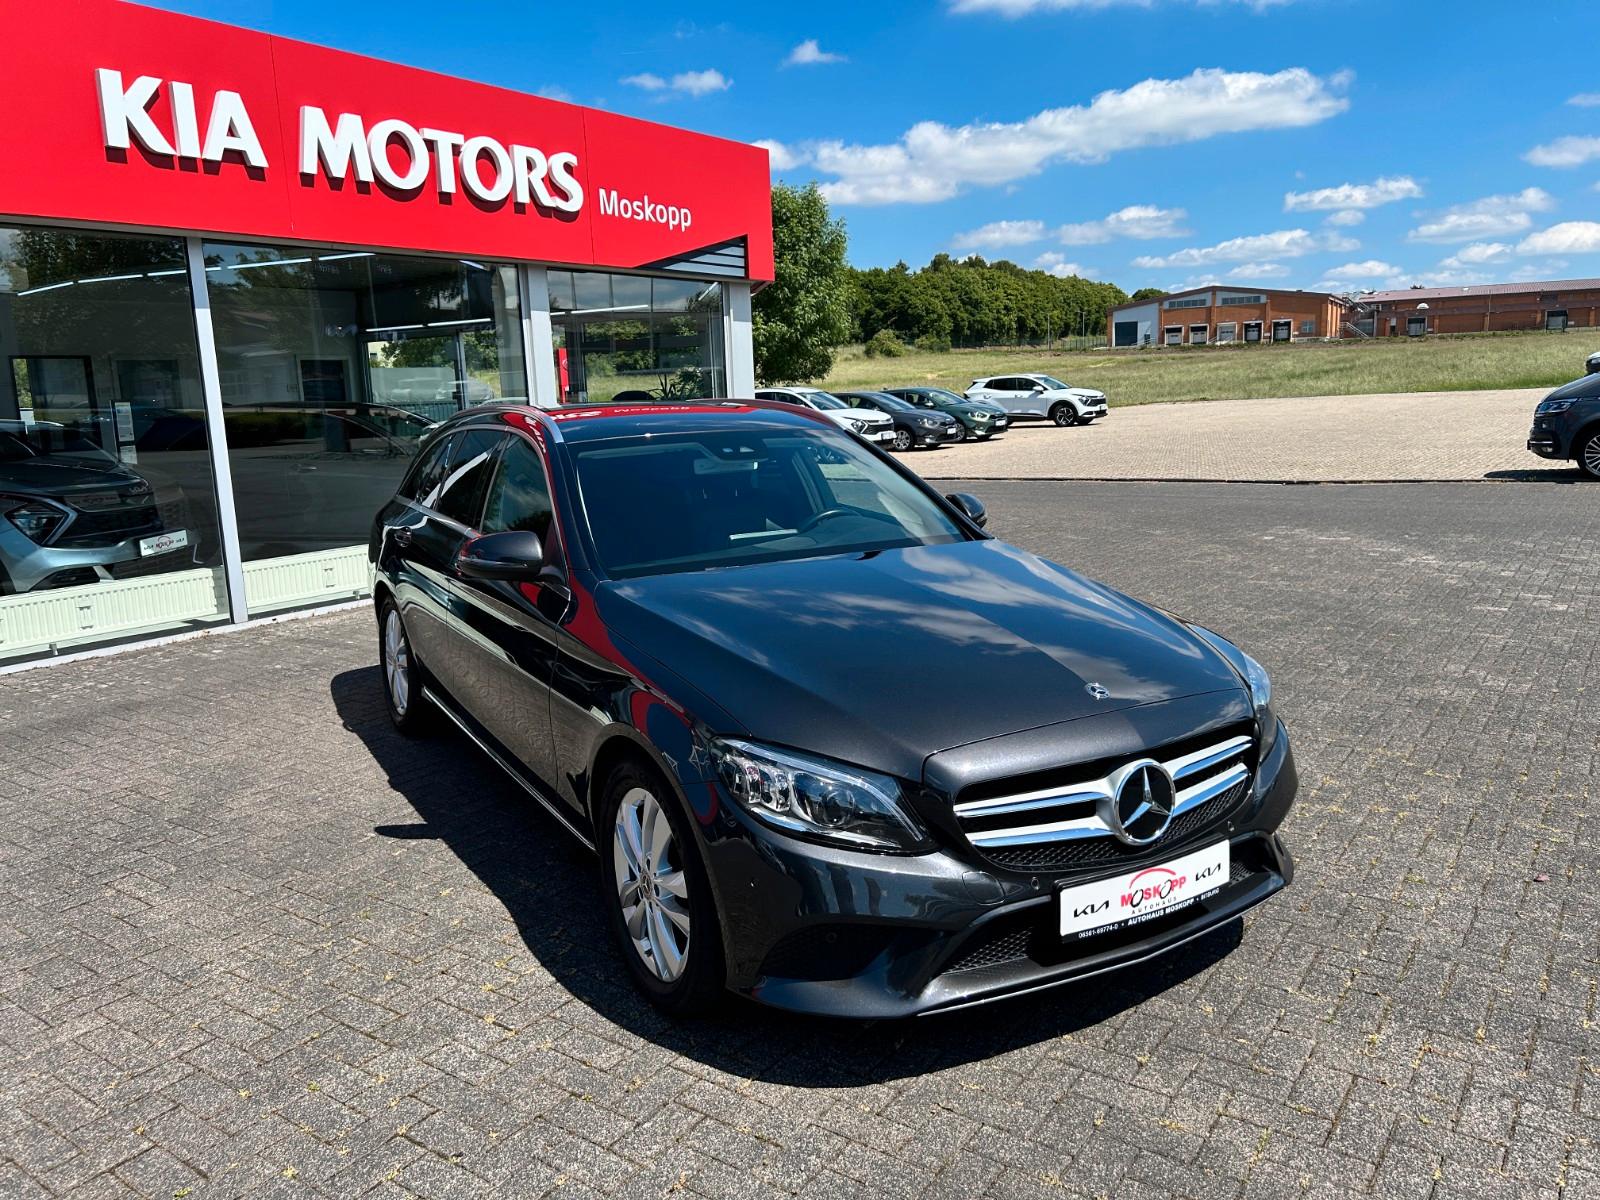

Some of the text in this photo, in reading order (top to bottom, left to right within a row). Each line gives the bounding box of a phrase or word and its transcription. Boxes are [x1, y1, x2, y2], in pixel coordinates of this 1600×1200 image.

[96, 68, 584, 213] KIA MOTORS
[599, 188, 691, 232] Moskopp
[1195, 862, 1221, 882] KIA
[1120, 876, 1187, 908] MOSKOPP
[1131, 896, 1177, 915] AUTOHAUS
[1073, 900, 1110, 918] KIA
[1127, 909, 1165, 926] AUTOHAUS
[1165, 899, 1195, 915] MOSKOPP
